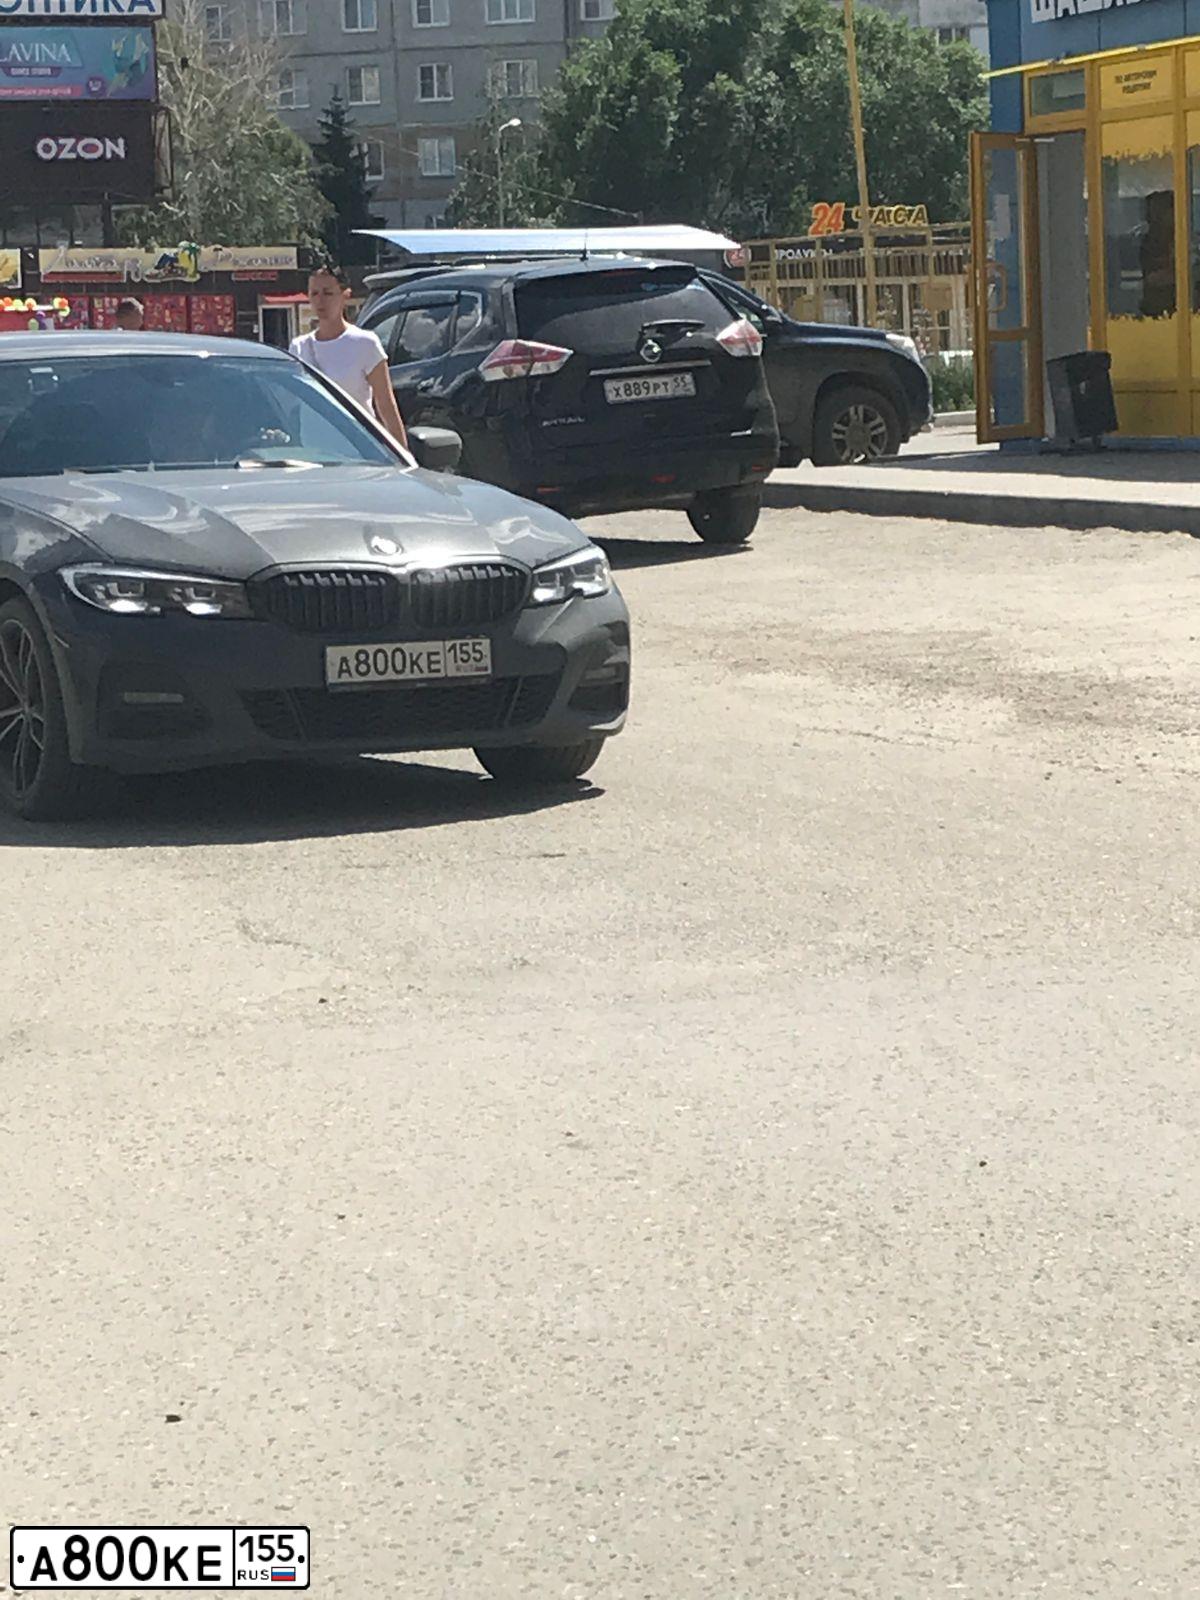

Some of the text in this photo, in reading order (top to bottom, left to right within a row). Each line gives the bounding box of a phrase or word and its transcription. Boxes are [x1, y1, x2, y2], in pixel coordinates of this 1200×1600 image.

[36, 137, 125, 160] OZON
[809, 202, 846, 236] 24
[337, 642, 484, 679] А800КЕ 155
